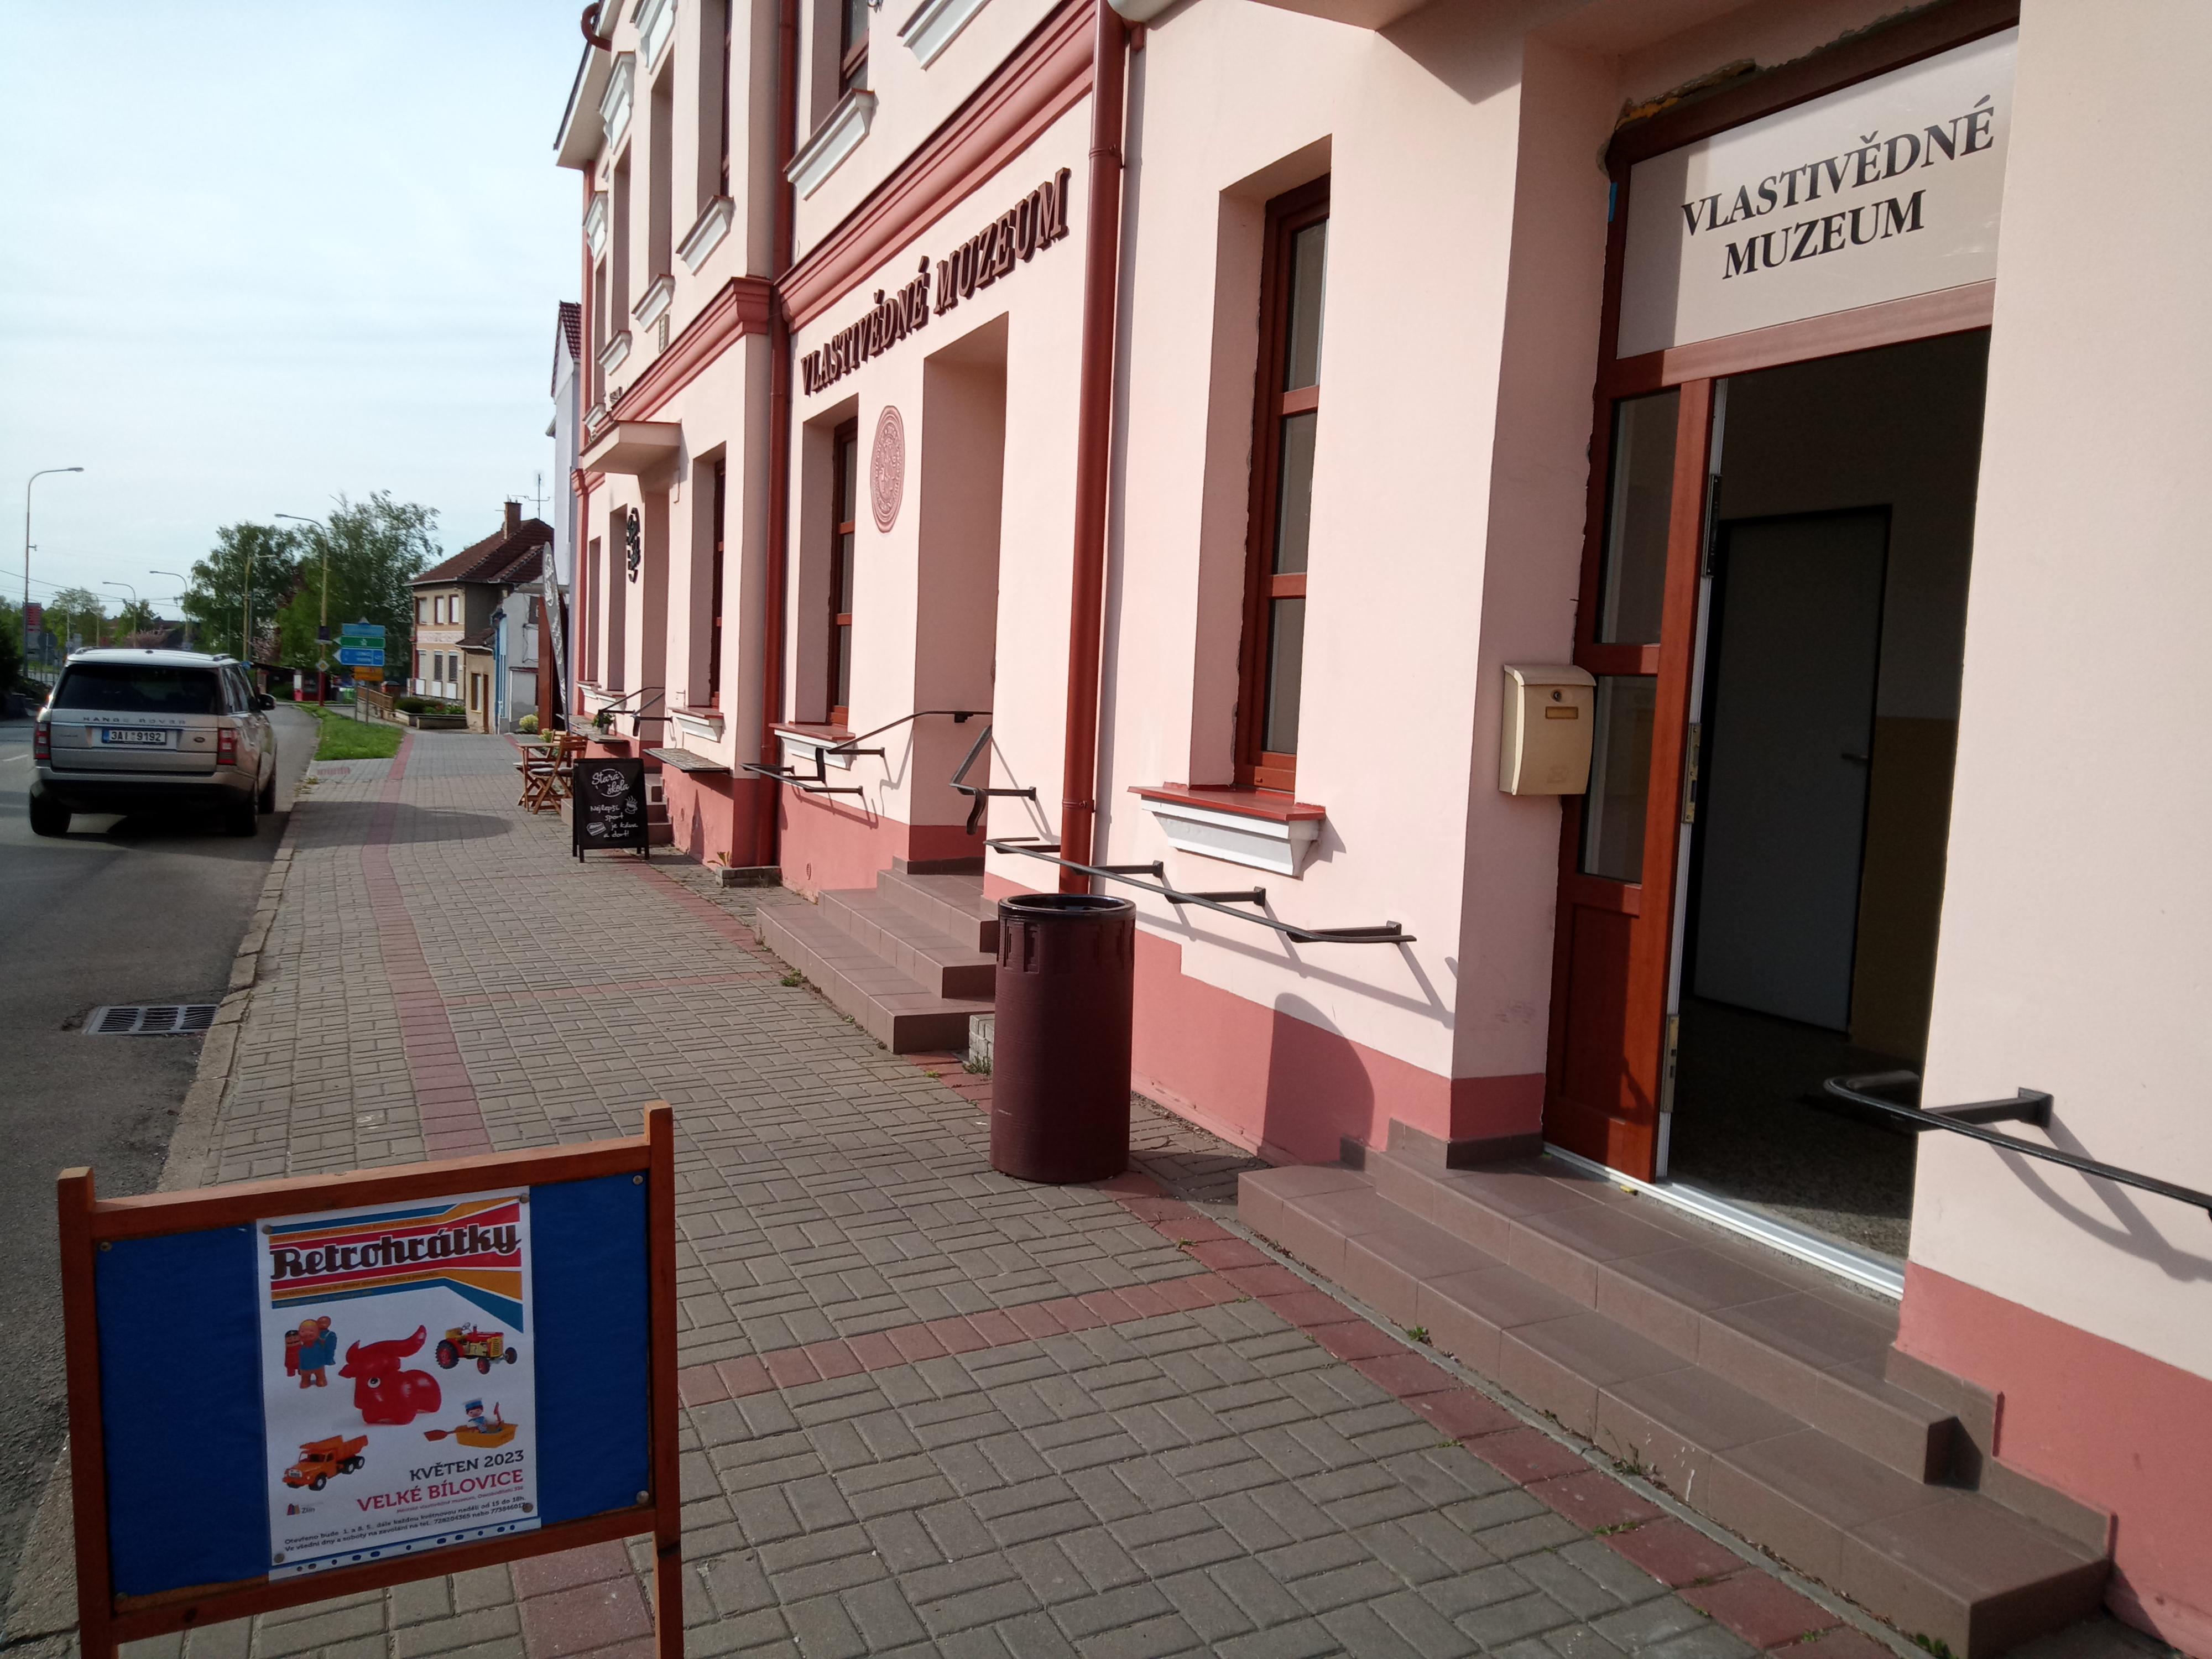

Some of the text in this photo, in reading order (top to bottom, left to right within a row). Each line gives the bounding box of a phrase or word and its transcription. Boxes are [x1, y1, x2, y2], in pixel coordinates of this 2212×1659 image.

[1681, 94, 1994, 236] VLASTIVĚDNÉ
[1722, 189, 1926, 279] MUZEUM
[801, 167, 1071, 397] VLASTIVĚDNÉ MUZEUM
[138, 732, 161, 741] 9192
[592, 771, 619, 785] Stará
[607, 780, 629, 795] škola
[590, 805, 620, 813] Nejlepší
[605, 812, 624, 822] sport
[611, 822, 618, 831] je
[270, 1224, 521, 1281] Retrohrátky
[410, 1450, 524, 1481] KVĚTEN 2023
[357, 1469, 523, 1512] VELKÉ BÍLOVICE
[284, 1535, 318, 1545] Otevřeno
[296, 1541, 319, 1550] všední
[321, 1537, 335, 1546] dny
[379, 1525, 408, 1534] zavolání
[472, 1509, 489, 1517] nebo
